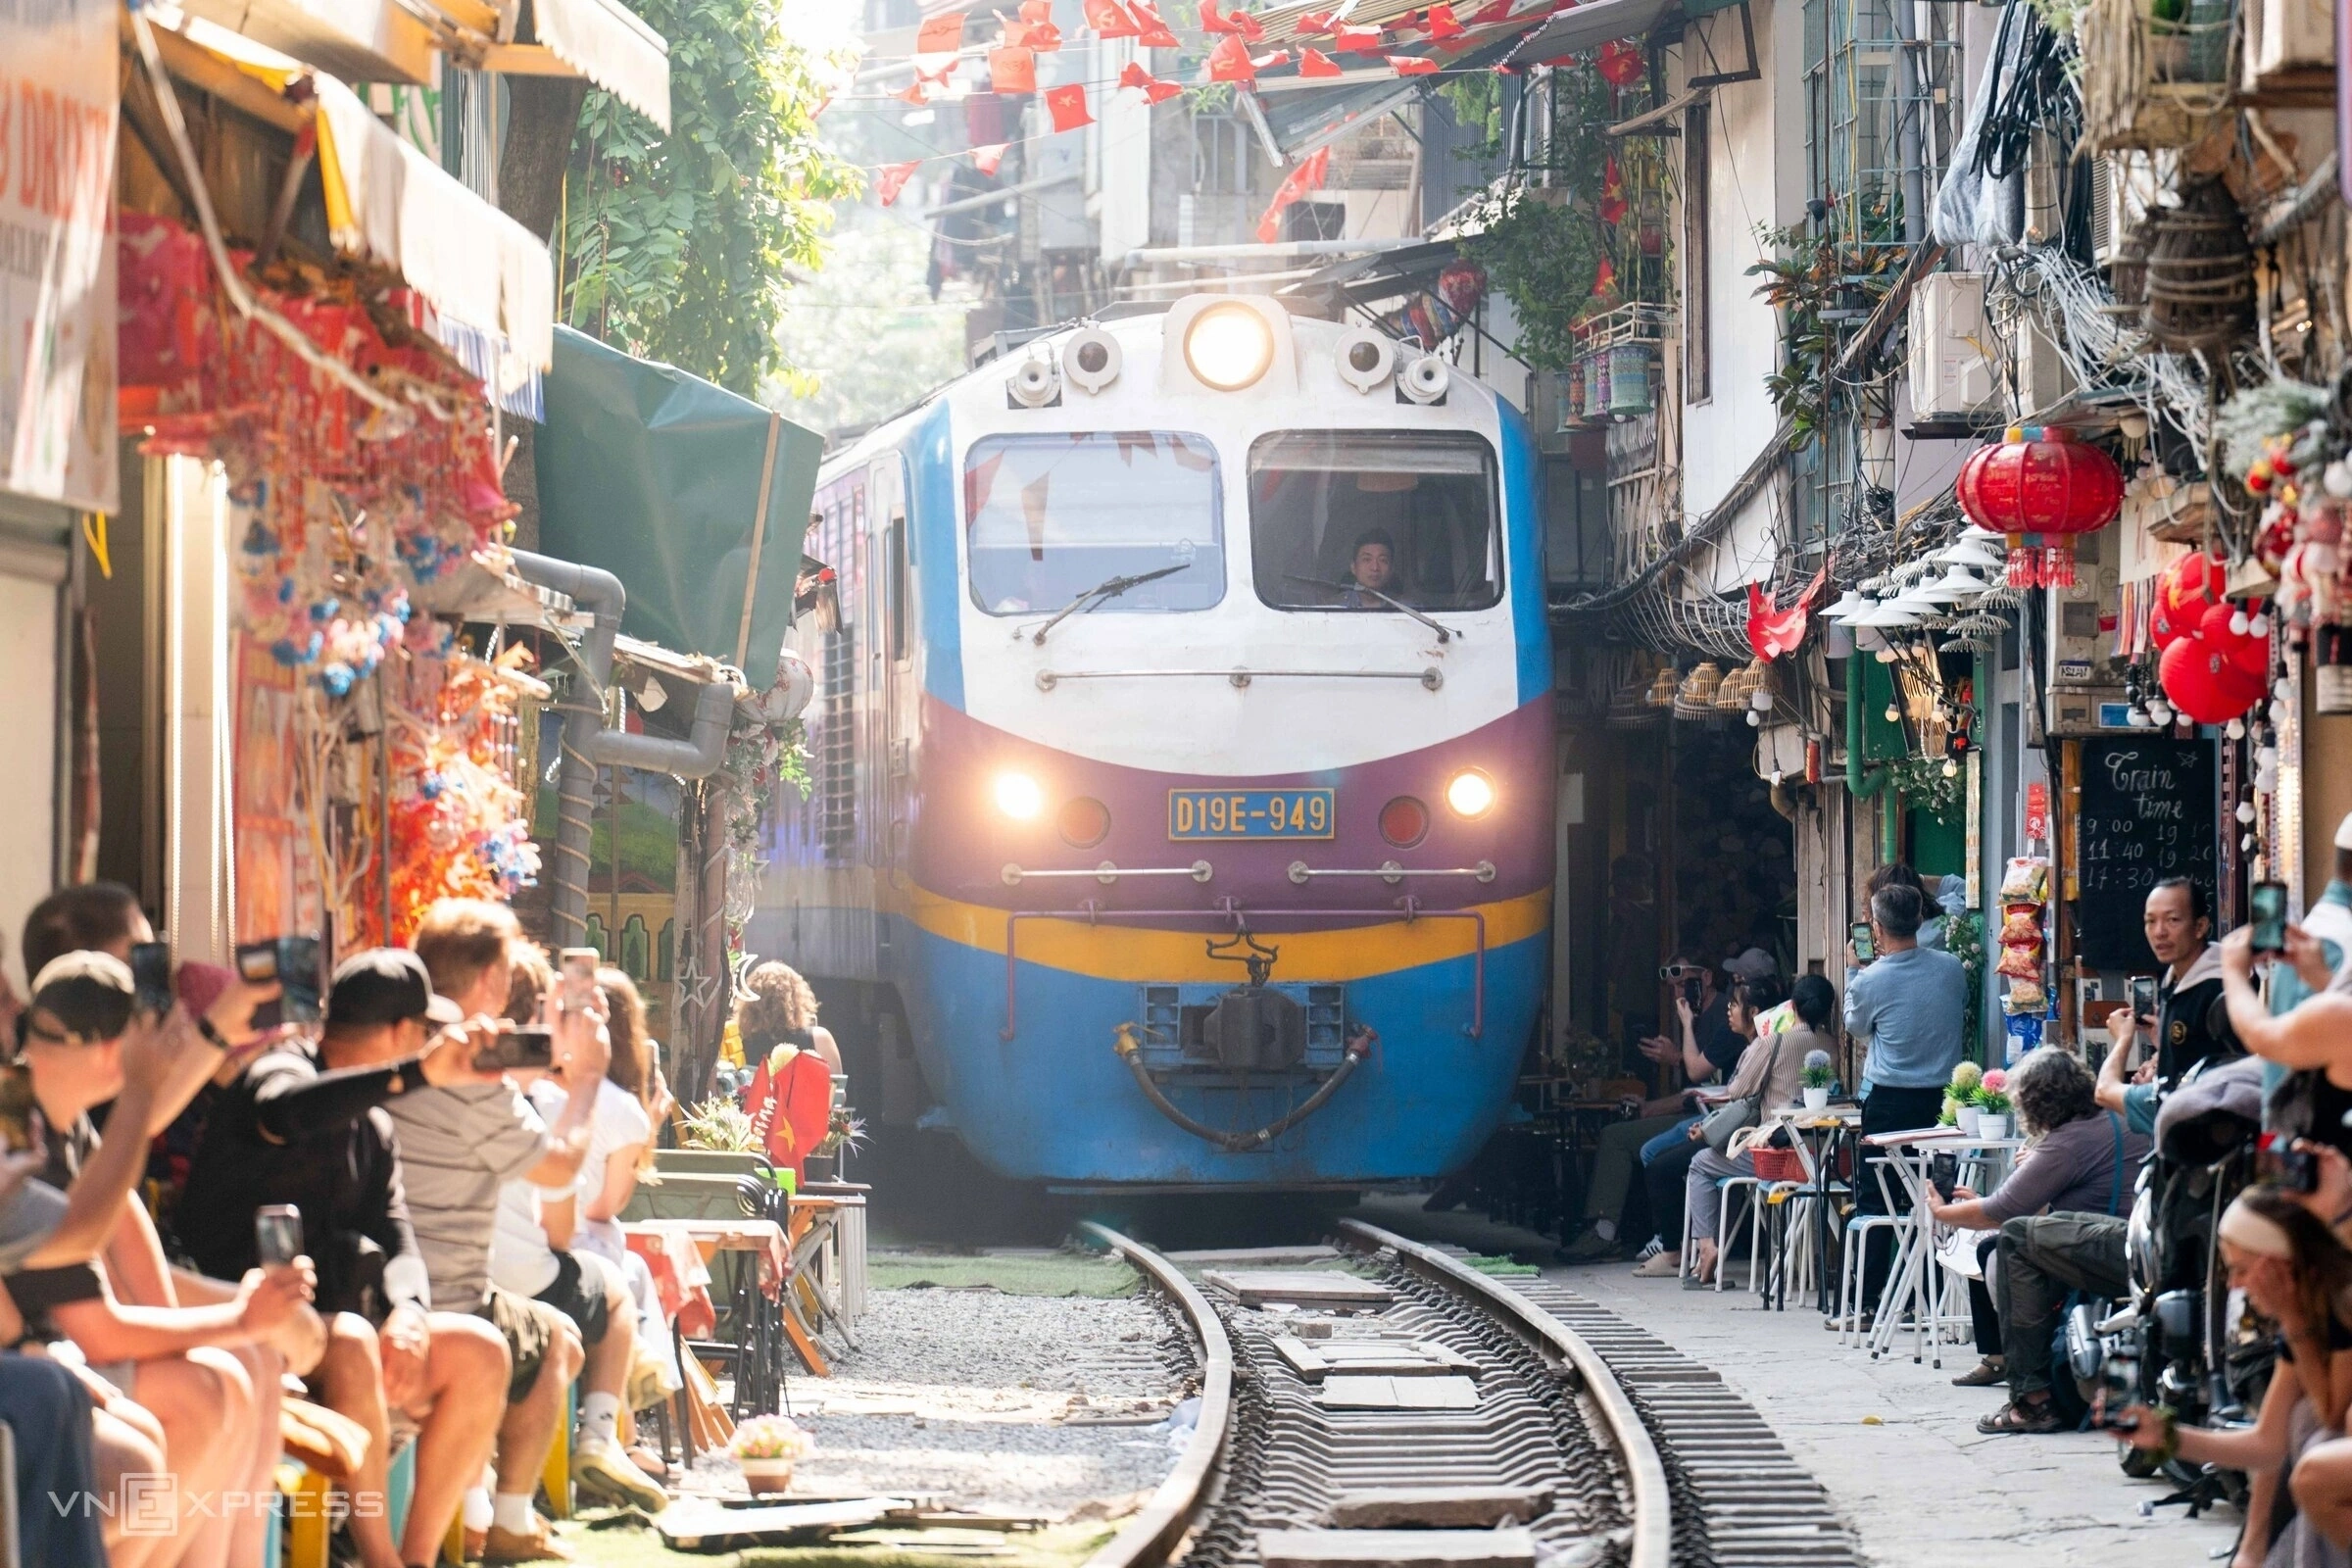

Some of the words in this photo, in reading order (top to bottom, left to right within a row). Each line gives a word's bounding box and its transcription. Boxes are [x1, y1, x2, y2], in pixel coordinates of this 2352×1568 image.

[2105, 751, 2177, 792] Train
[1177, 796, 1326, 832] D19E-949
[2132, 792, 2183, 819] time
